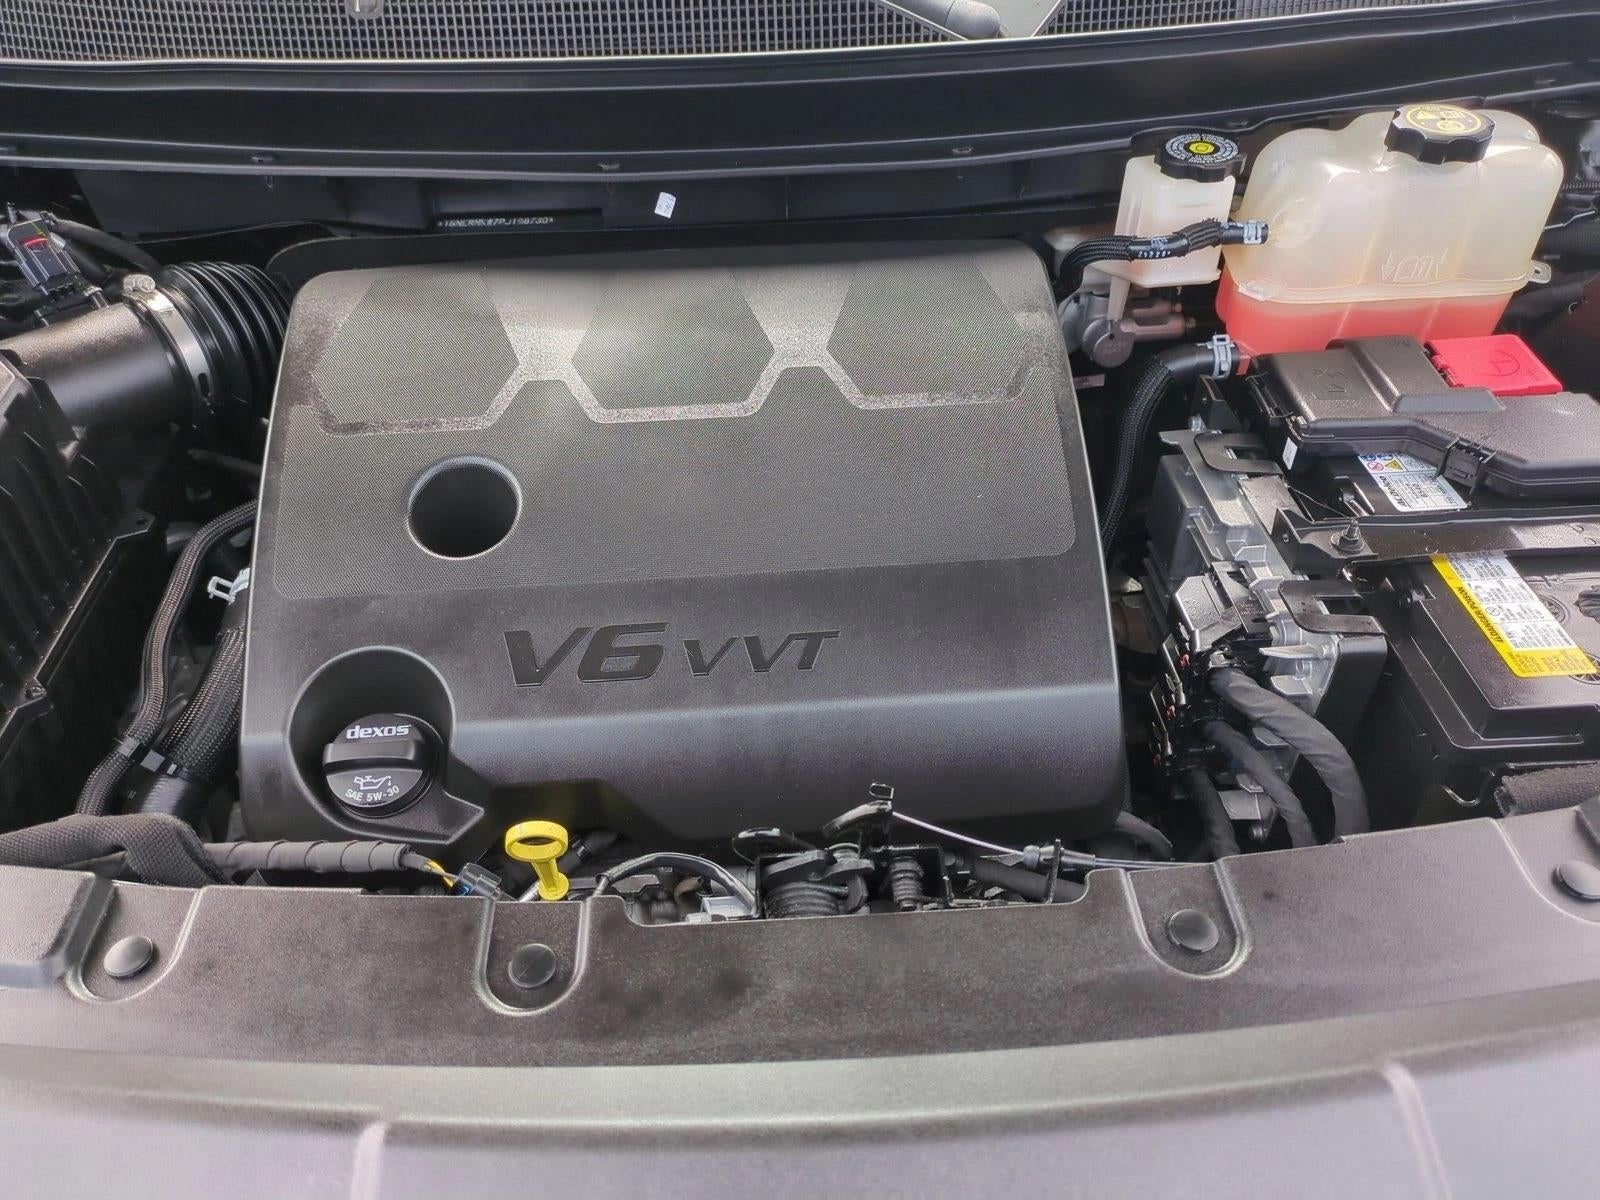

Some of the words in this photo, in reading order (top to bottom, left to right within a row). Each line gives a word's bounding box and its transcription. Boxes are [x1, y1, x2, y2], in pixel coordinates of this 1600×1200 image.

[1456, 586, 1480, 610] POISON
[1475, 611, 1499, 637] DANGER
[503, 622, 669, 687] V6
[683, 630, 841, 677] VVT
[346, 725, 412, 739] dexos
[345, 788, 364, 802] SAE
[366, 785, 400, 802] 5W-30
